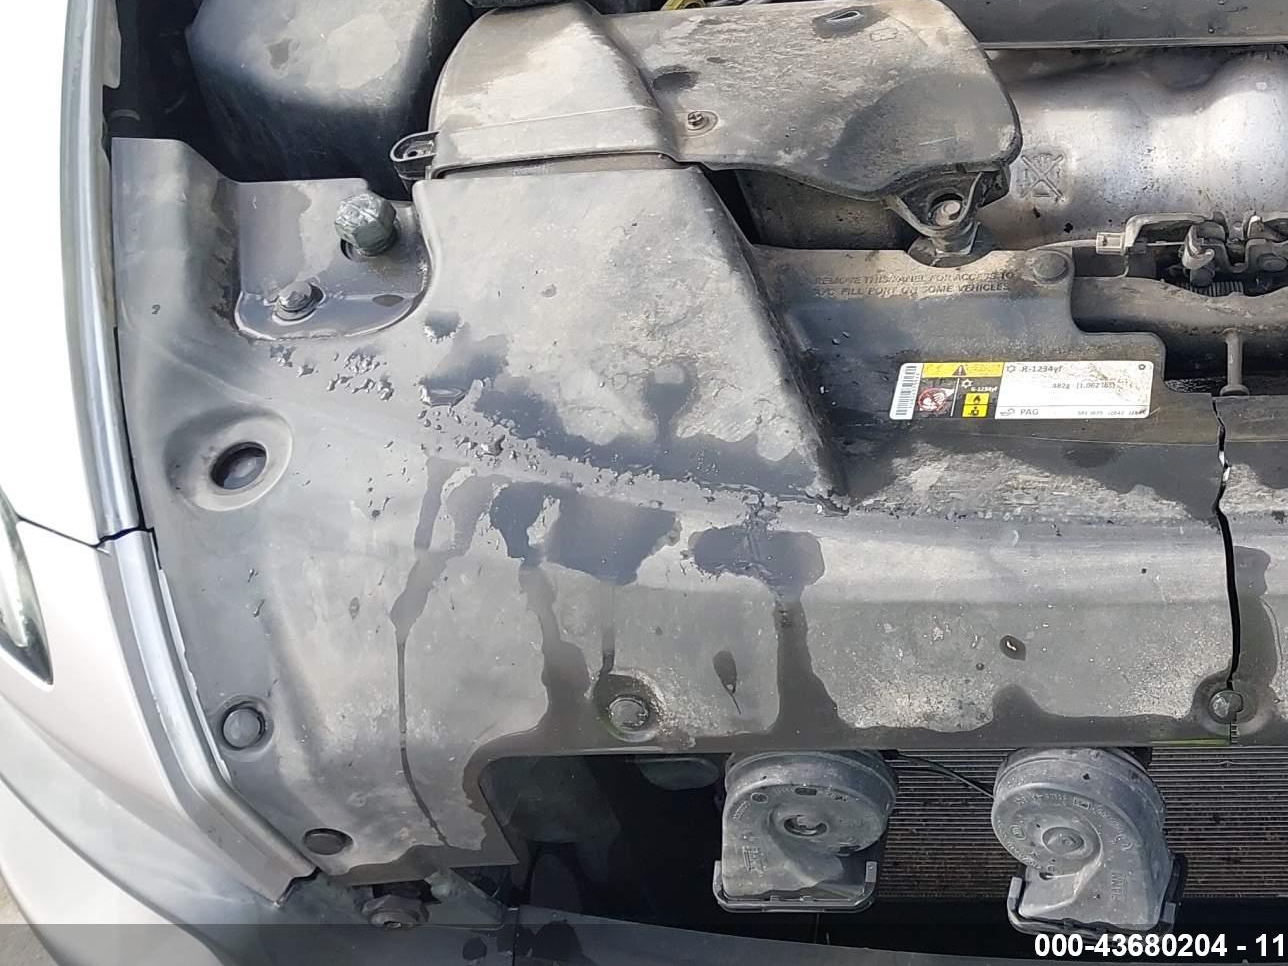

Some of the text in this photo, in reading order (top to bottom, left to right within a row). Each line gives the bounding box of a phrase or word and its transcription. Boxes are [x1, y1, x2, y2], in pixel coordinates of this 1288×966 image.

[840, 287, 864, 296] FILL
[958, 282, 1010, 293] VEHICLES
[1021, 365, 1063, 373] R-1234yf
